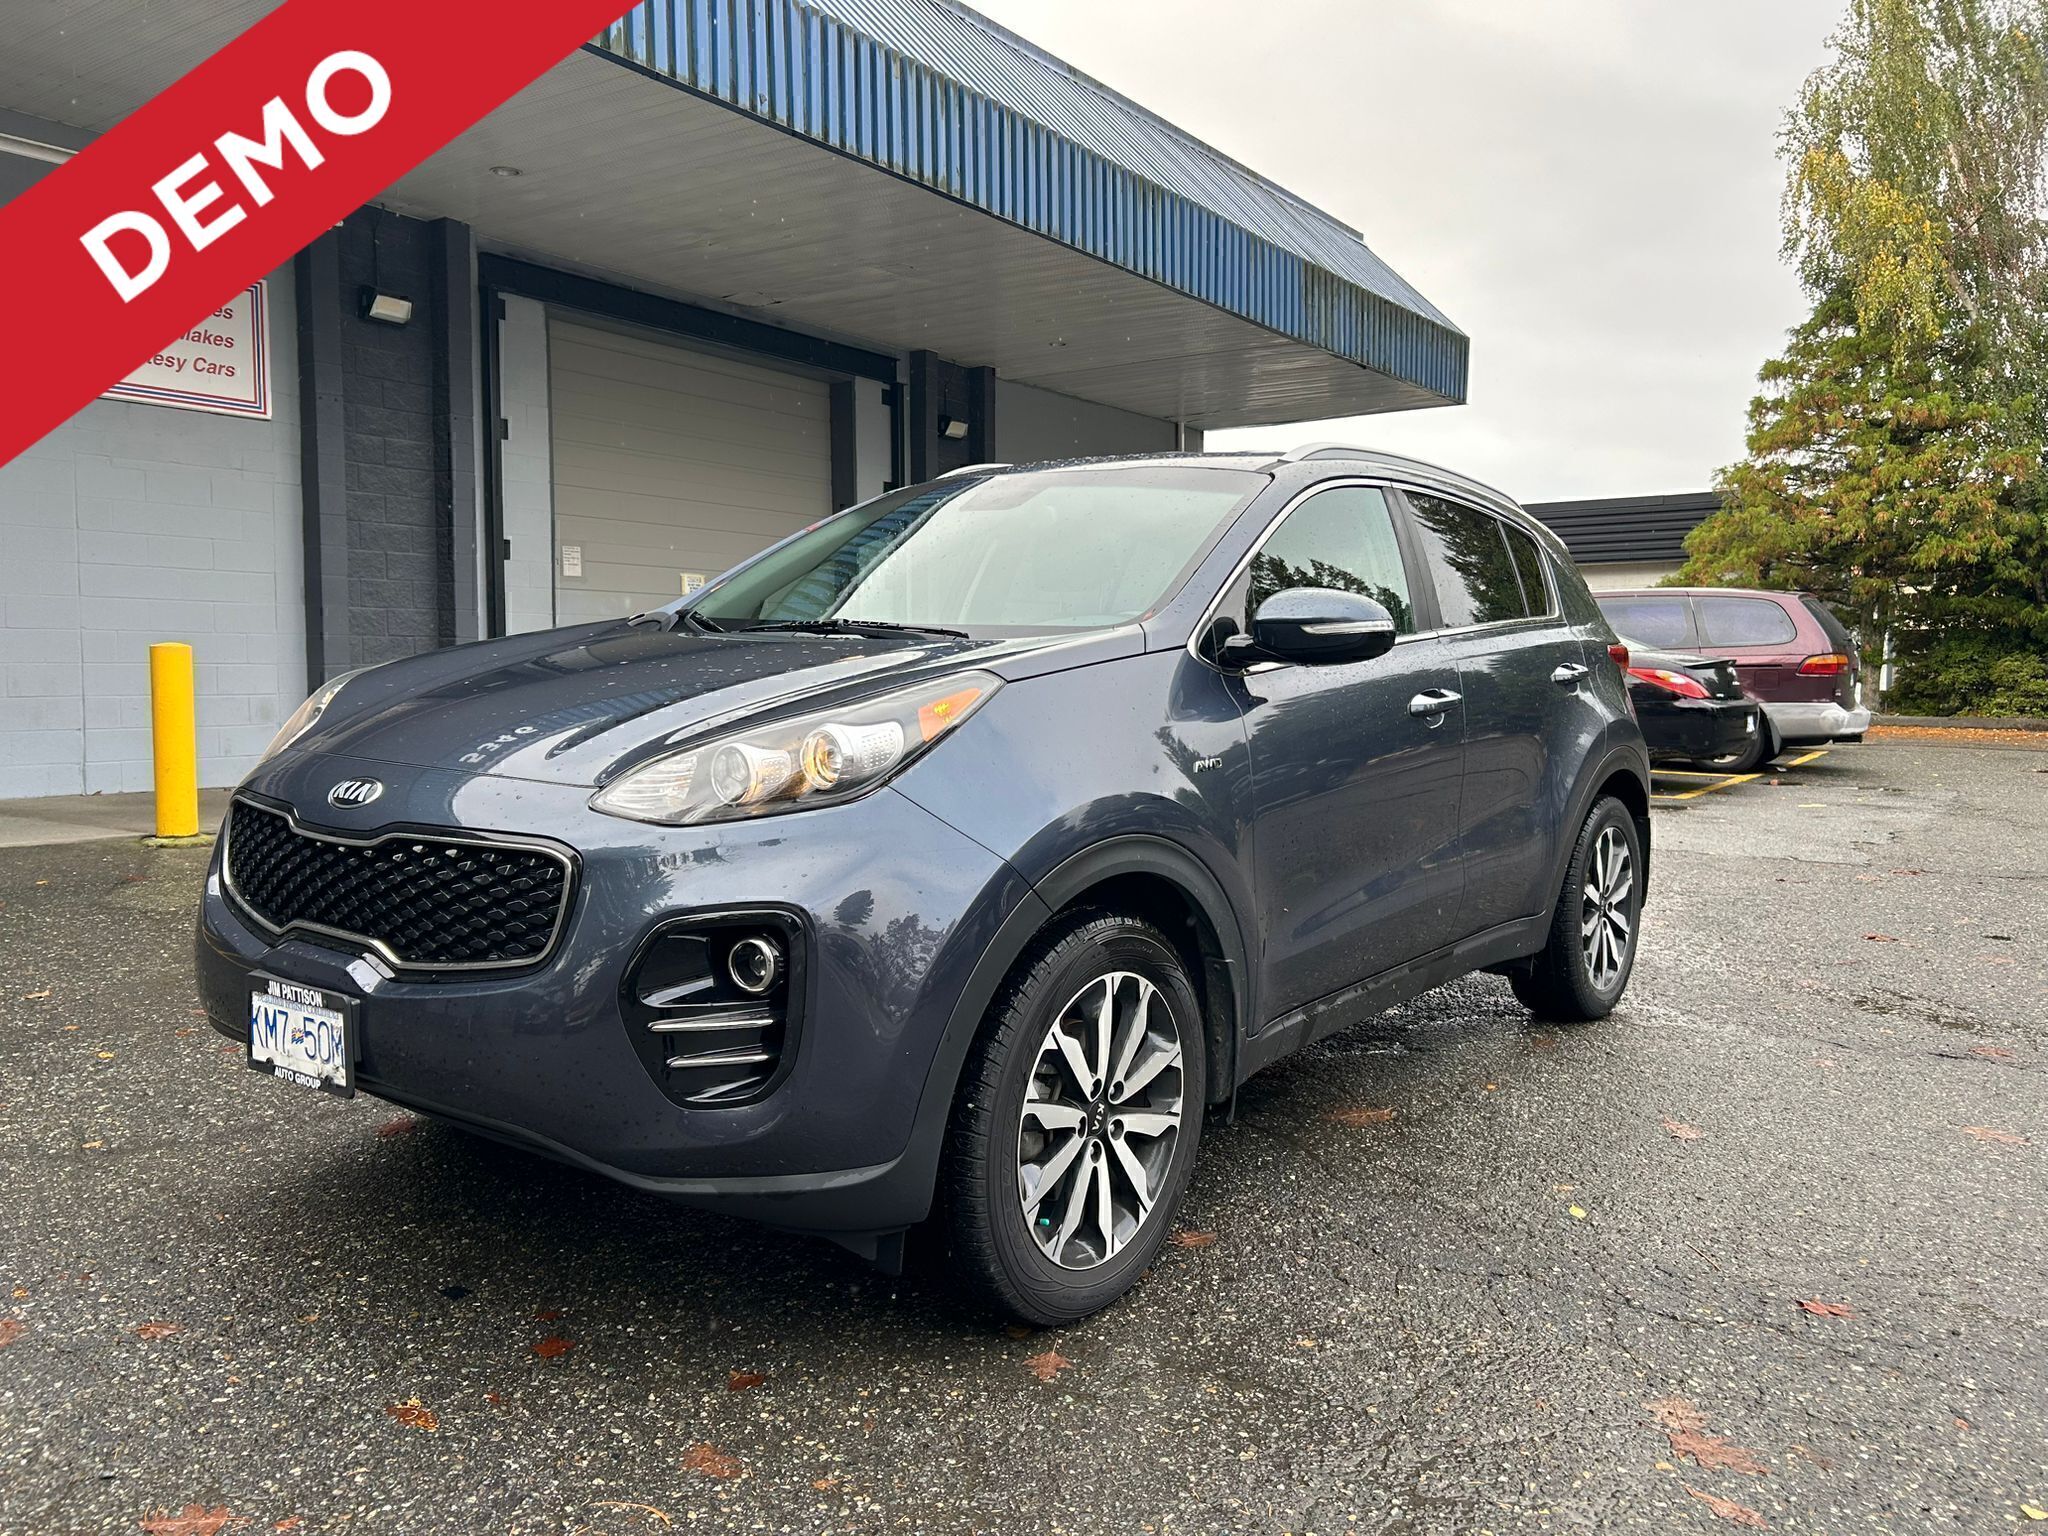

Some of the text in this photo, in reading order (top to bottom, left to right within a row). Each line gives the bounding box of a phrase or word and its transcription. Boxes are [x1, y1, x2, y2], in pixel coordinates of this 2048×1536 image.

[193, 357, 236, 378] Cars
[333, 780, 372, 802] KIA
[267, 980, 281, 997] JIM
[281, 984, 323, 1007] PATTISON
[274, 1066, 321, 1089] AUTO GROUP
[1092, 1103, 1105, 1130] KIA
